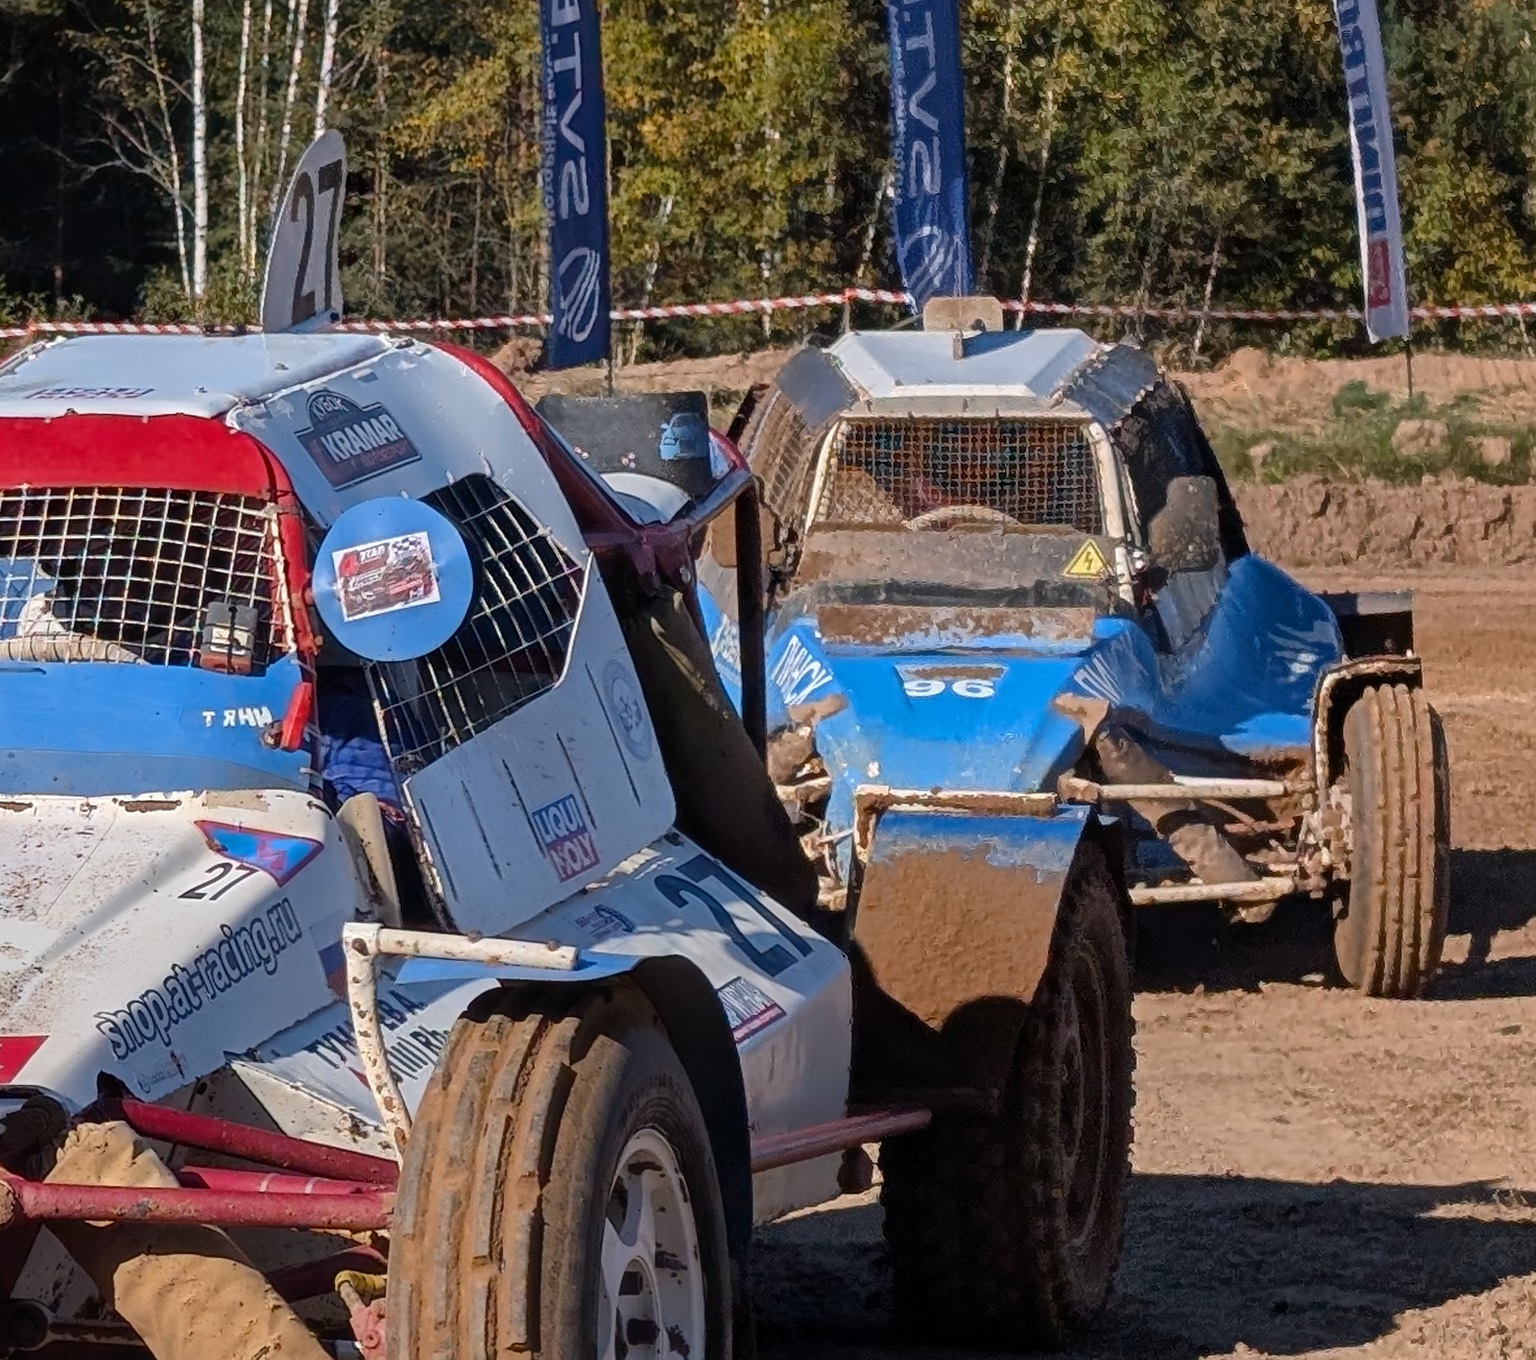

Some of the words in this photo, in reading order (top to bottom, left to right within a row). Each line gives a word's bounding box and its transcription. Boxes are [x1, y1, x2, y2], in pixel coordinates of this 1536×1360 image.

[291, 159, 342, 325] 27
[311, 396, 346, 421] КУБОК
[320, 413, 404, 462] KRAMAR
[771, 635, 833, 706] ПИНСК
[904, 679, 995, 698] 96
[535, 797, 584, 844] LIQUI
[550, 831, 596, 878] MOLY
[178, 862, 259, 901] 27
[653, 853, 813, 977] 27
[94, 897, 303, 1060] shop.at-racing.ru
